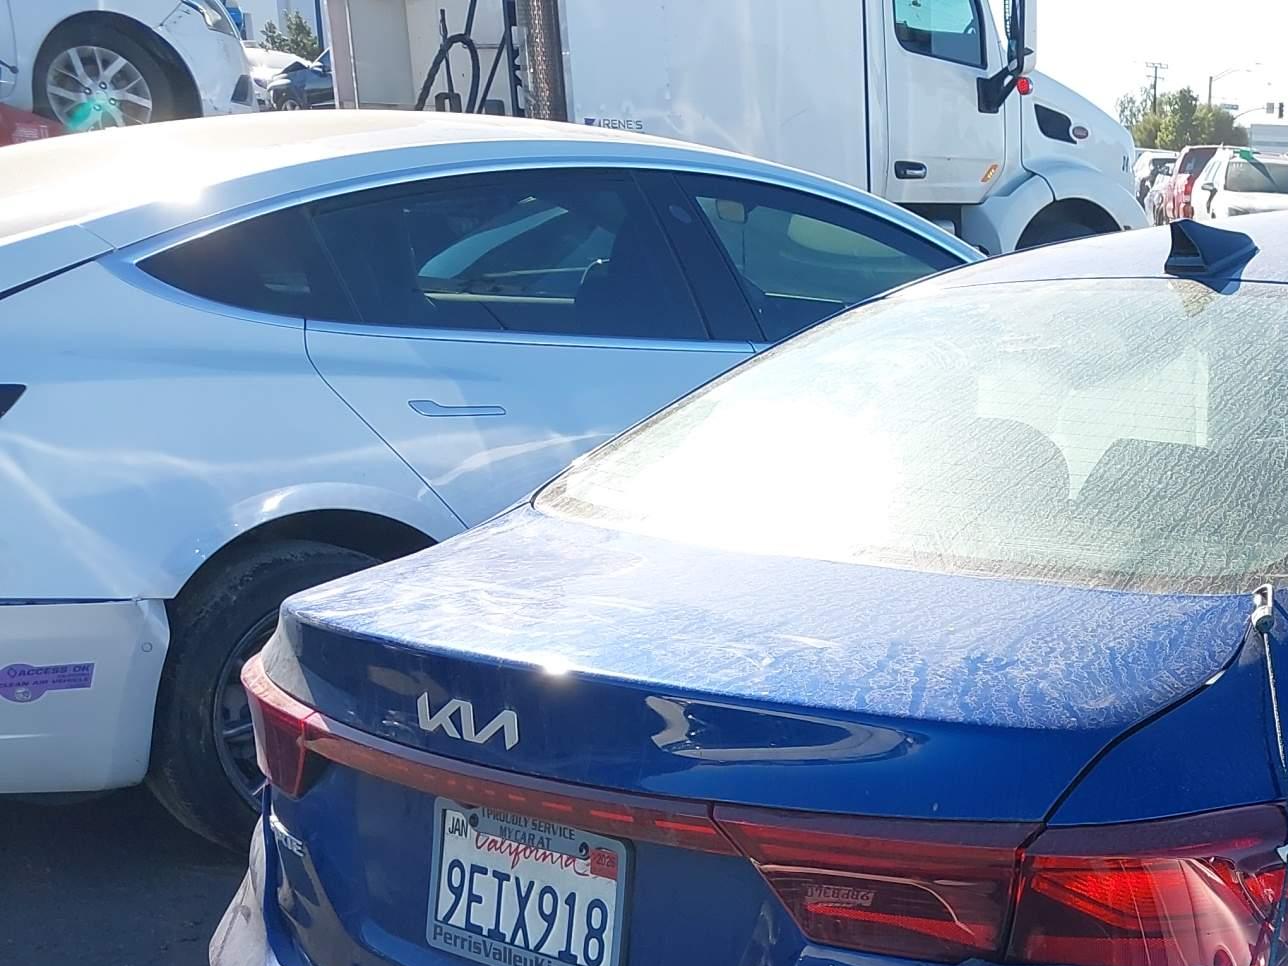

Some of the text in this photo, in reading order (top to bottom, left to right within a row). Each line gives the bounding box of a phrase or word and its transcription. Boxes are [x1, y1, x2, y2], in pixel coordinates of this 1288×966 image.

[18, 666, 68, 677] ACCESS
[417, 691, 519, 751] KIA
[448, 816, 468, 839] JAN
[487, 808, 528, 827] PROUDLY
[531, 819, 576, 840] SERVICE
[500, 825, 552, 850] MY CAR AT
